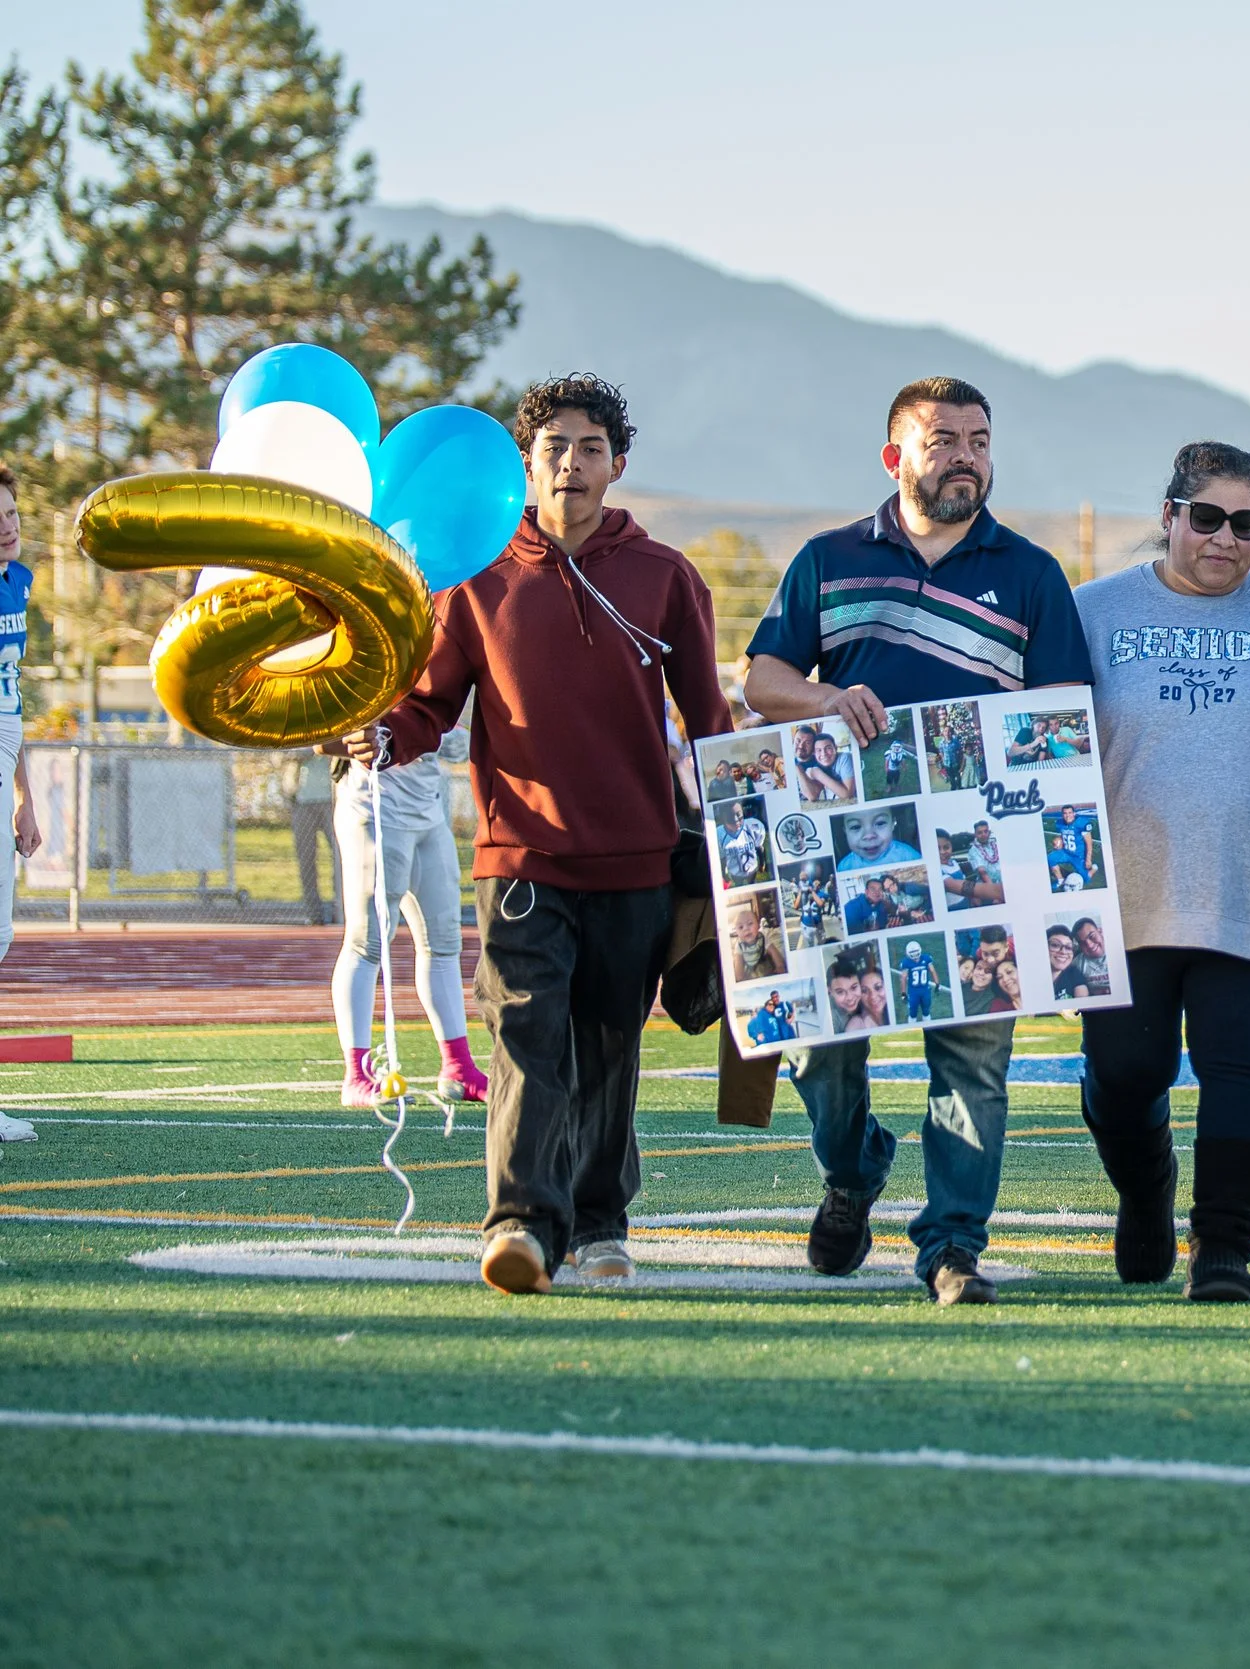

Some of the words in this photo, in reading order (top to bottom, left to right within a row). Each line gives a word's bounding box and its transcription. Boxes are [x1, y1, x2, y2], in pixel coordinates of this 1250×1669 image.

[1159, 661, 1210, 678] class
[1218, 665, 1238, 681] of
[1159, 685, 1181, 700] 20
[1213, 688, 1236, 703] 27
[979, 778, 1045, 820] Pack
